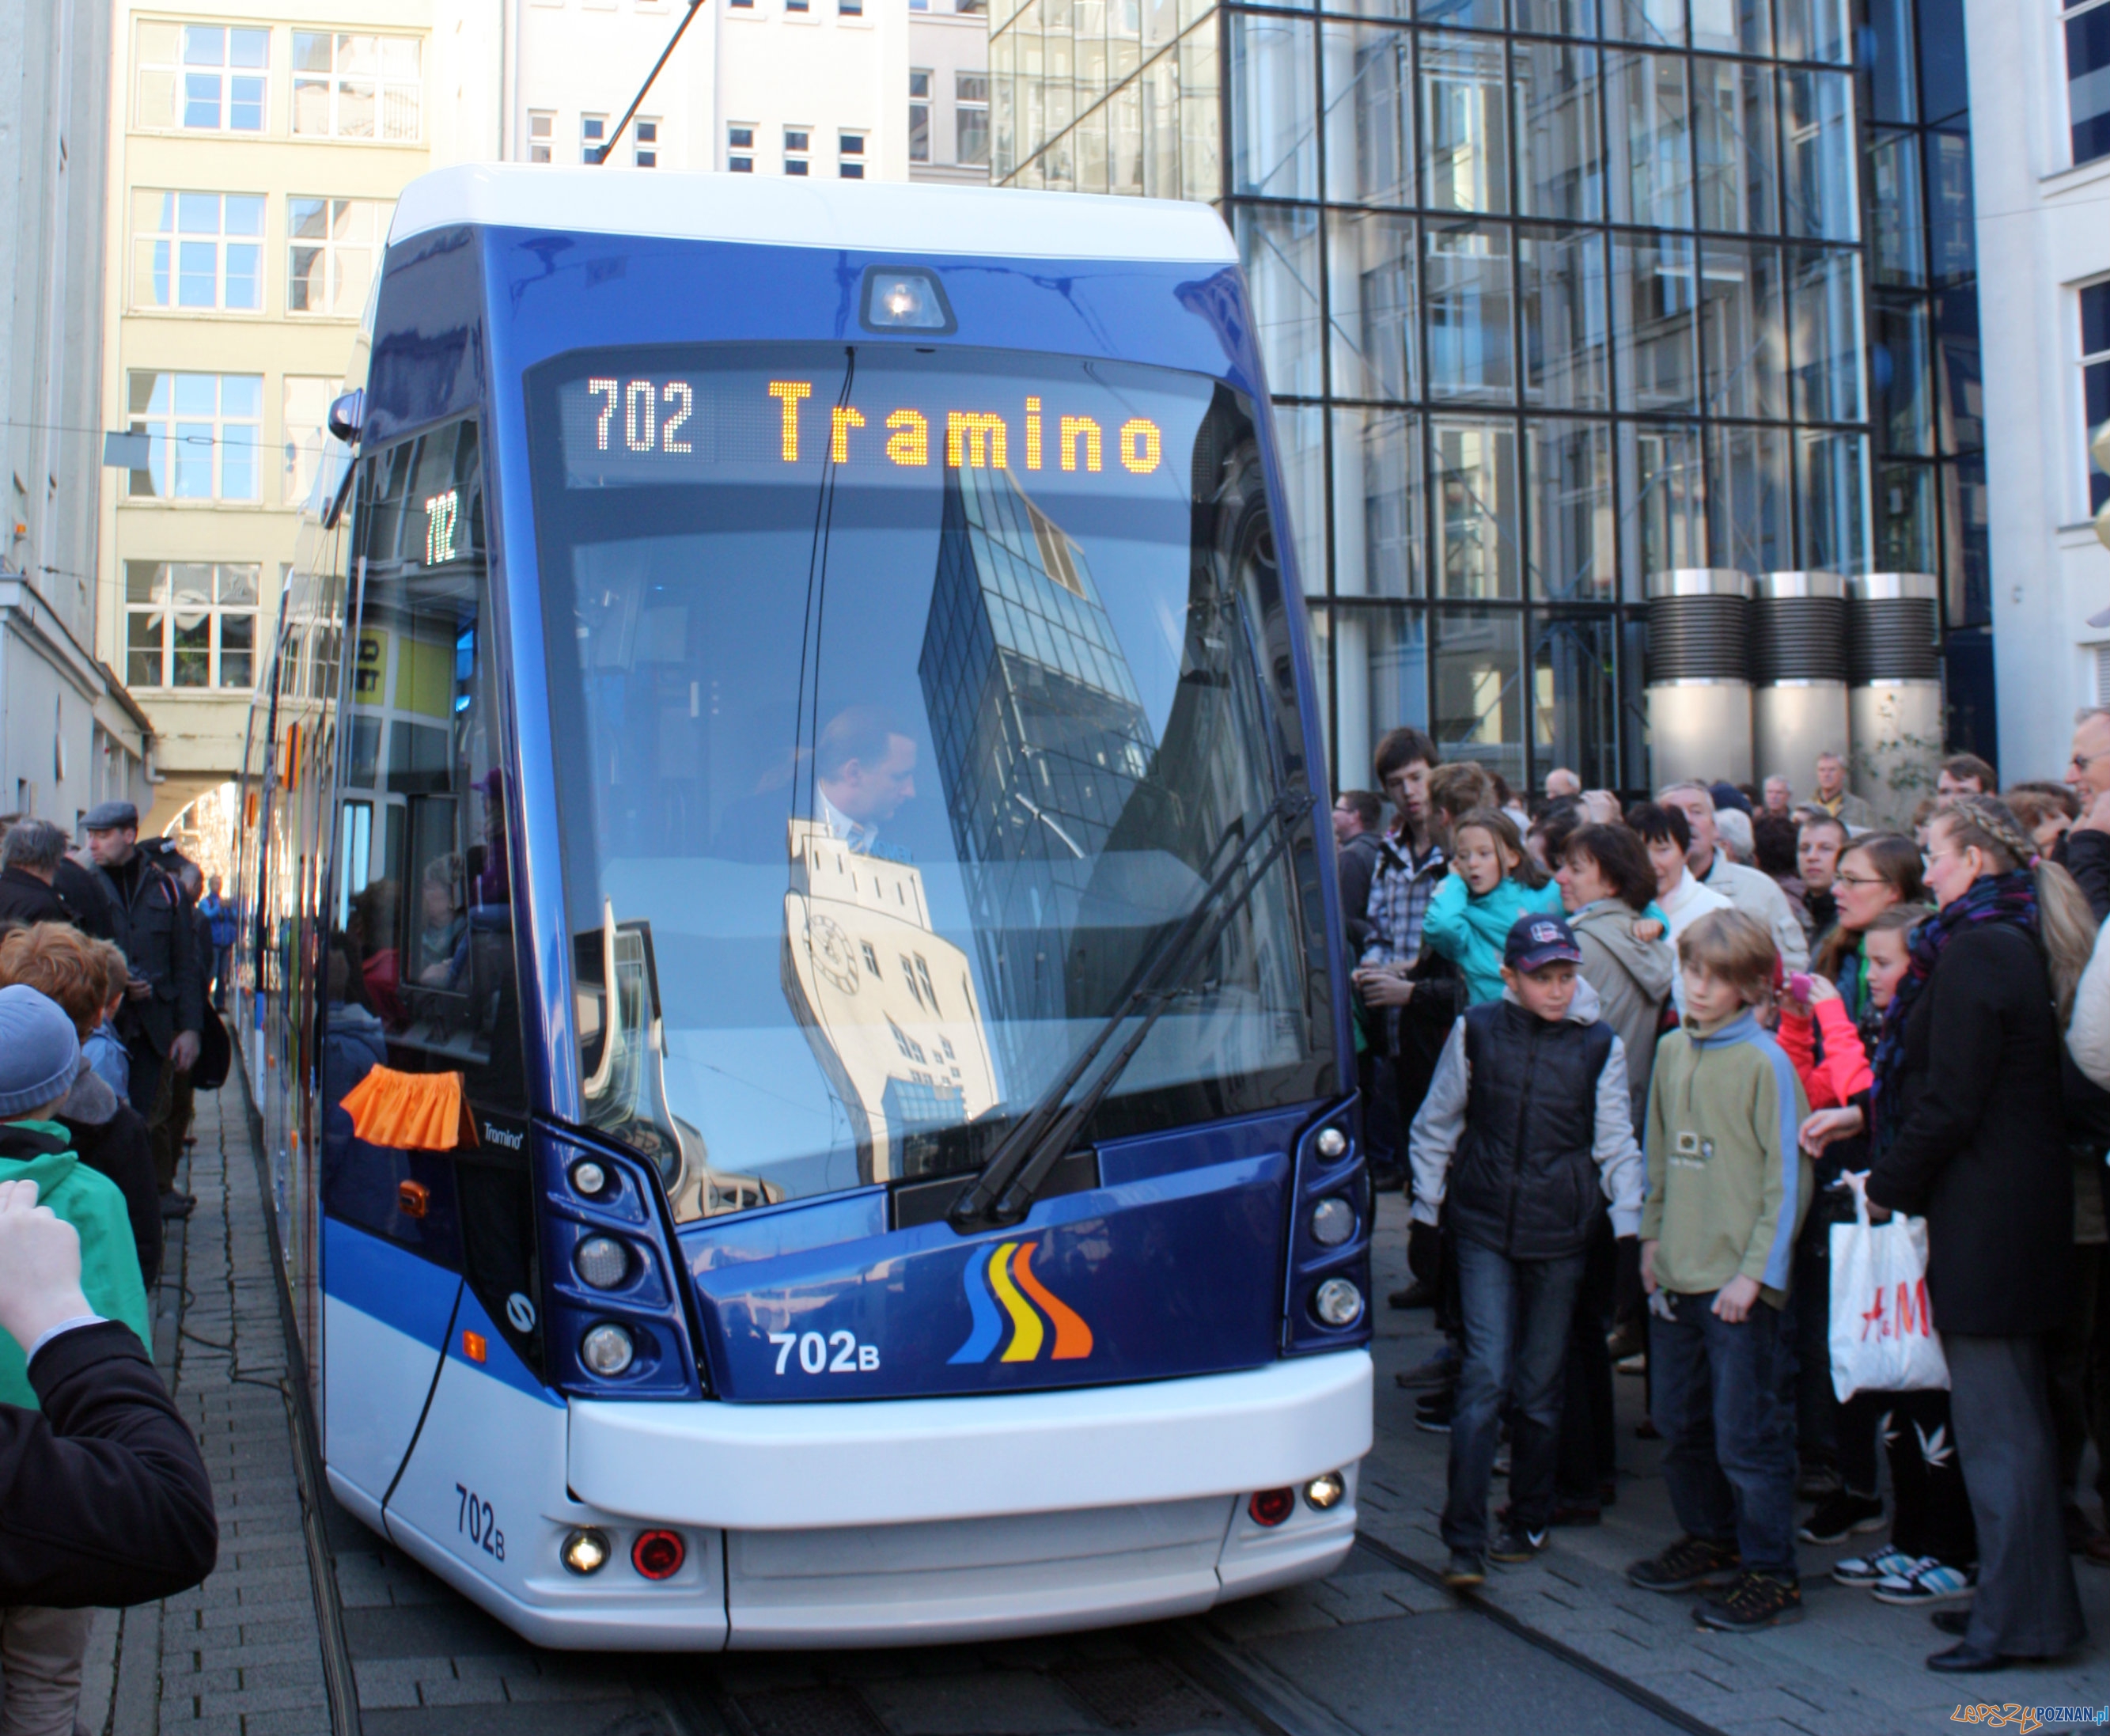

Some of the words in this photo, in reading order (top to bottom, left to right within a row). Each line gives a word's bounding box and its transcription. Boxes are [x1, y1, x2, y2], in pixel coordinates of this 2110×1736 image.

[588, 378, 693, 453] 702
[768, 380, 1161, 474] Tramino
[484, 1121, 522, 1150] Tramino
[1862, 1277, 1930, 1344] H&M
[768, 1329, 881, 1375] 702B
[456, 1481, 506, 1562] 702B
